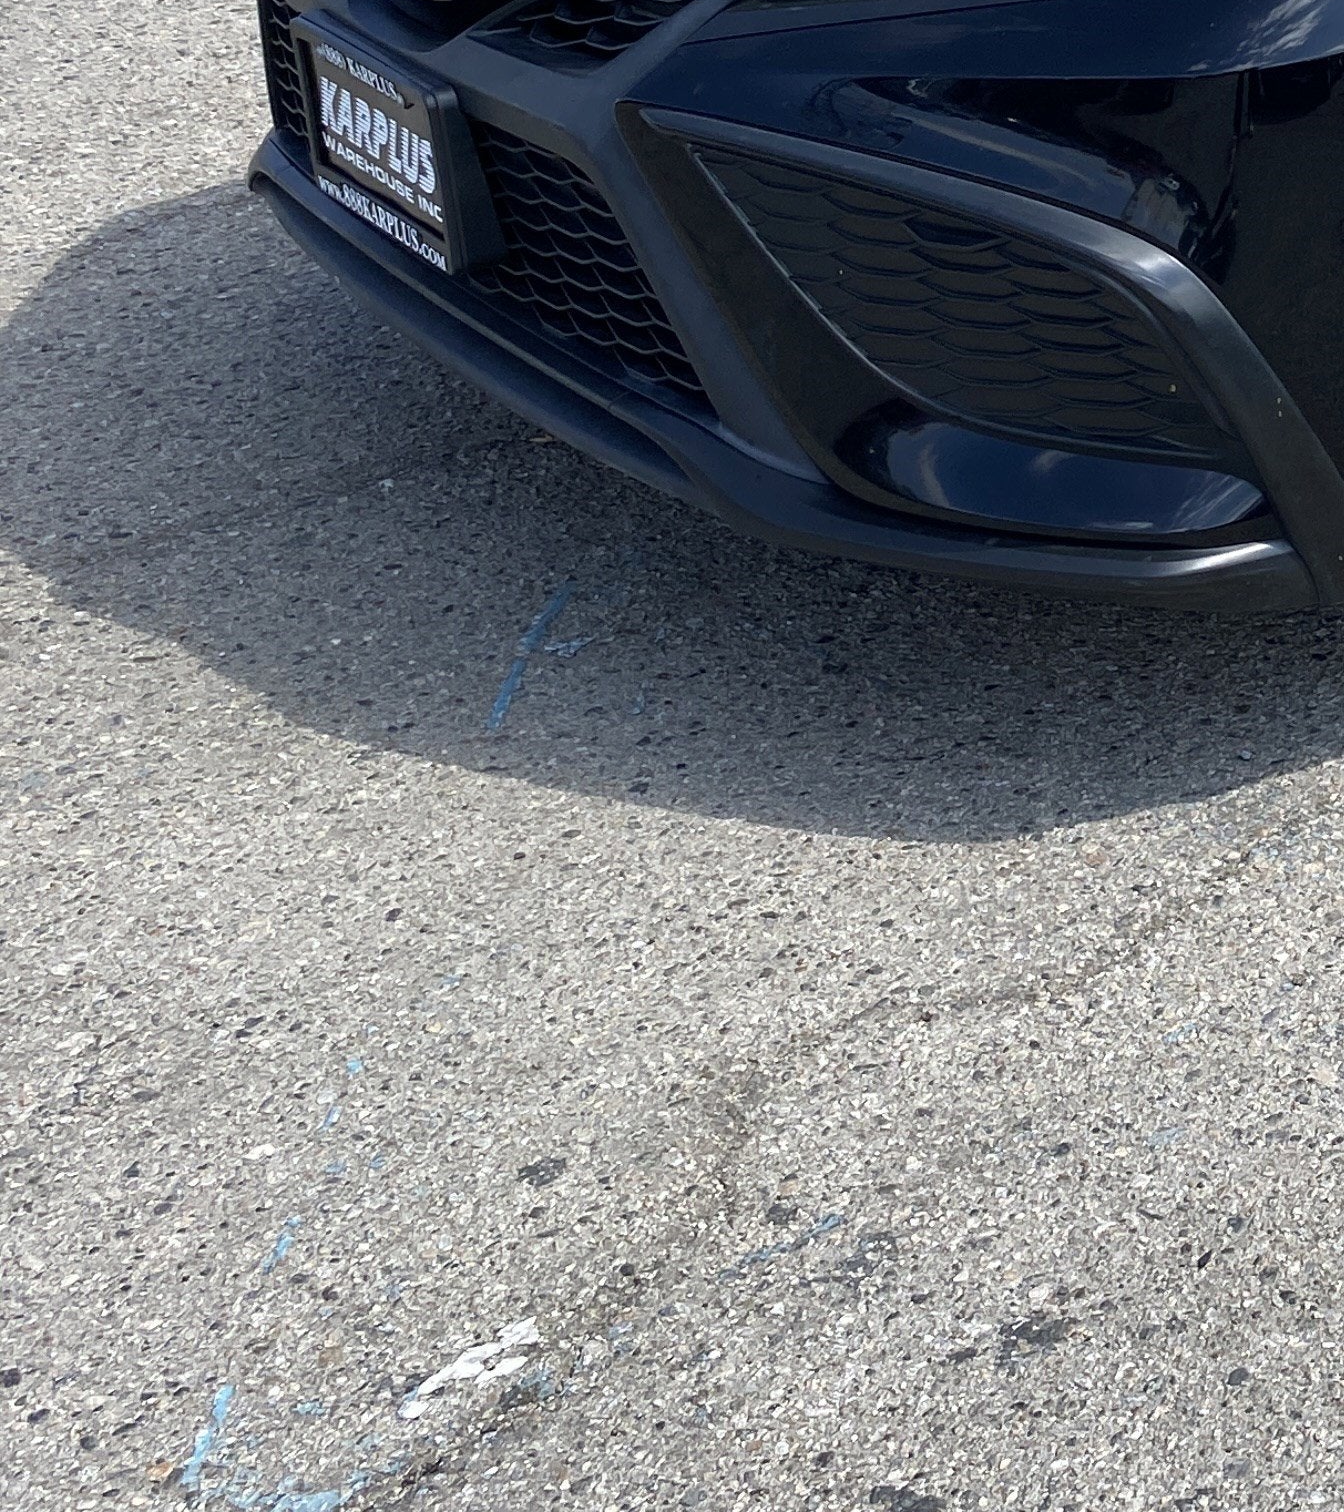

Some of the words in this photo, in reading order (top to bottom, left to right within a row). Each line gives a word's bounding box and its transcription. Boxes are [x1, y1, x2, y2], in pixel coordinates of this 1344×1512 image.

[319, 75, 437, 194] KARPLUS
[322, 131, 416, 205] WAREHOUSE
[417, 195, 444, 223] INC
